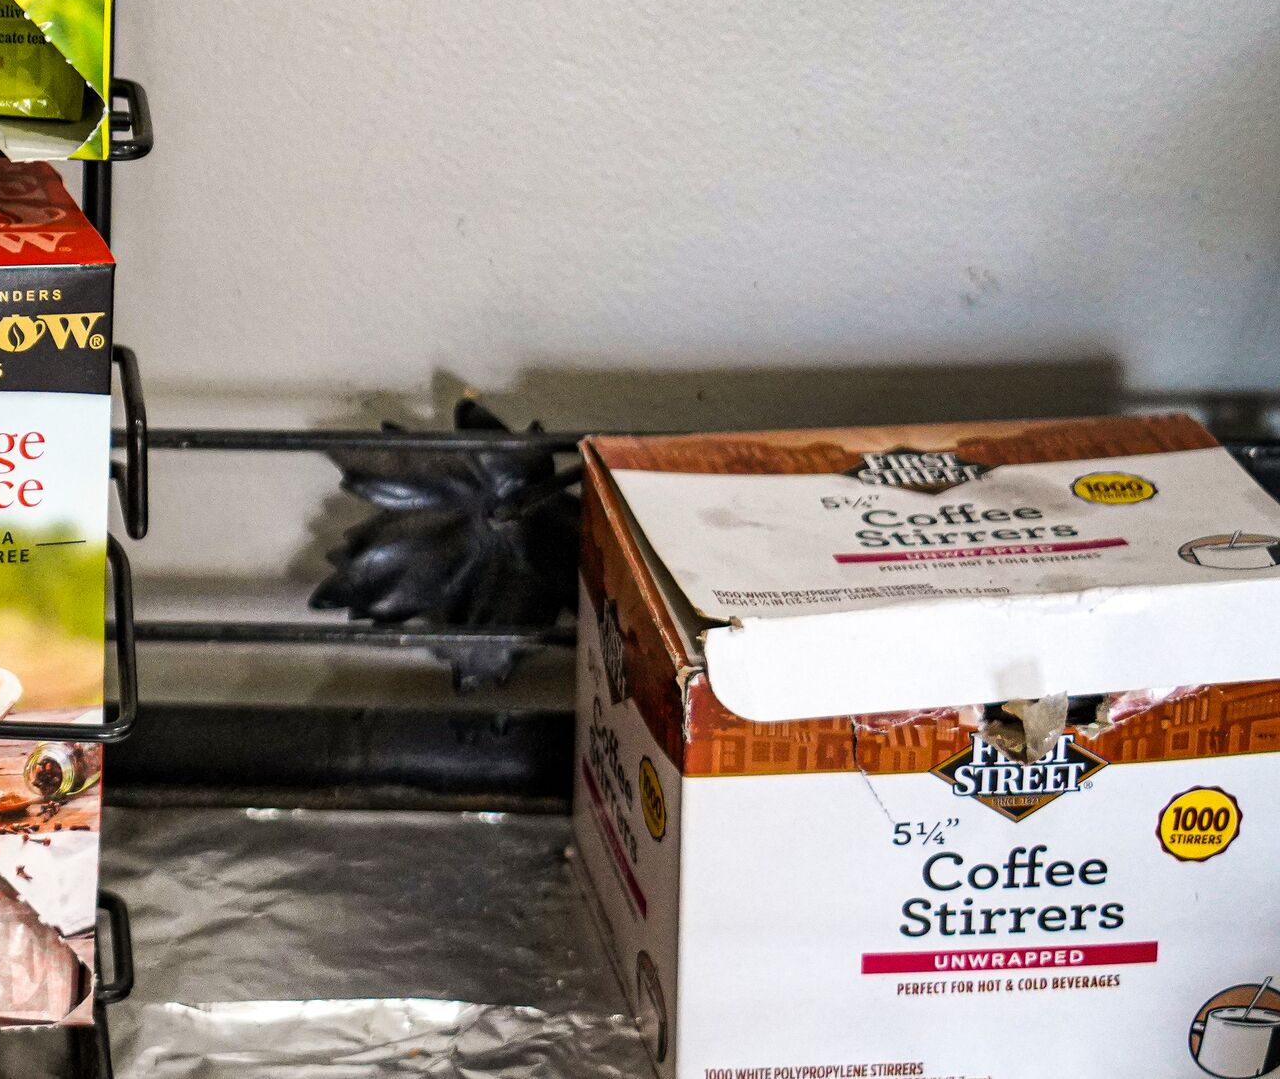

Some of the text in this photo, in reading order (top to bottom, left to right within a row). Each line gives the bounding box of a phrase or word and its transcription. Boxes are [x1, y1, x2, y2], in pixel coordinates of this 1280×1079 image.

[1084, 481, 1143, 493] 1000
[861, 504, 1043, 527] Coffee
[855, 525, 1079, 548] Stirrers
[879, 562, 928, 572] PERFECT
[932, 561, 955, 569] FOR
[969, 733, 1074, 765] FIT
[1172, 806, 1230, 833] 1000
[1169, 833, 1222, 845] STIRRERS
[922, 844, 1108, 891] Coffee
[899, 897, 1124, 937] Stirrers
[934, 950, 1084, 969] UNWRAPPED
[897, 974, 1121, 995] PERFECT FOR HOT & COLD BEVERAGES
[735, 1067, 772, 1079] WHITE
[774, 1064, 868, 1079] POLYPROPYLENE
[870, 1062, 924, 1076] STIRRERS
